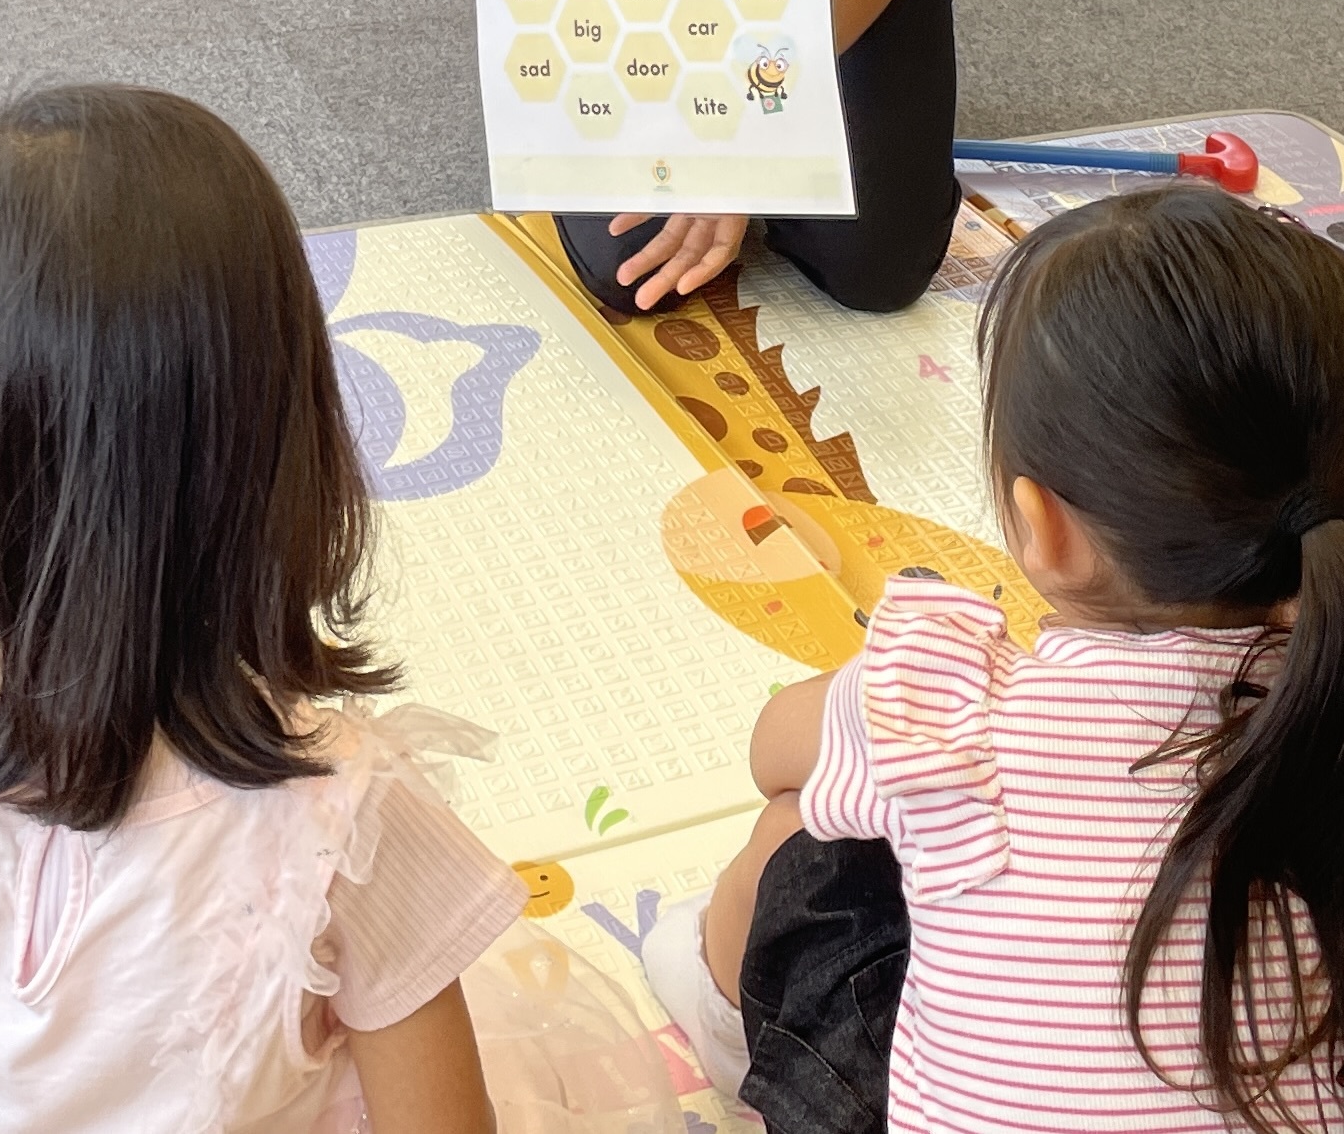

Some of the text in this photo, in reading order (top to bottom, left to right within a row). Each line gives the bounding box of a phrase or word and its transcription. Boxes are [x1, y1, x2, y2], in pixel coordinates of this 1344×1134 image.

[574, 20, 602, 42] big
[688, 22, 718, 36] car
[520, 60, 550, 78] sad
[626, 59, 669, 76] door
[578, 98, 612, 116] box
[694, 97, 728, 115] kite
